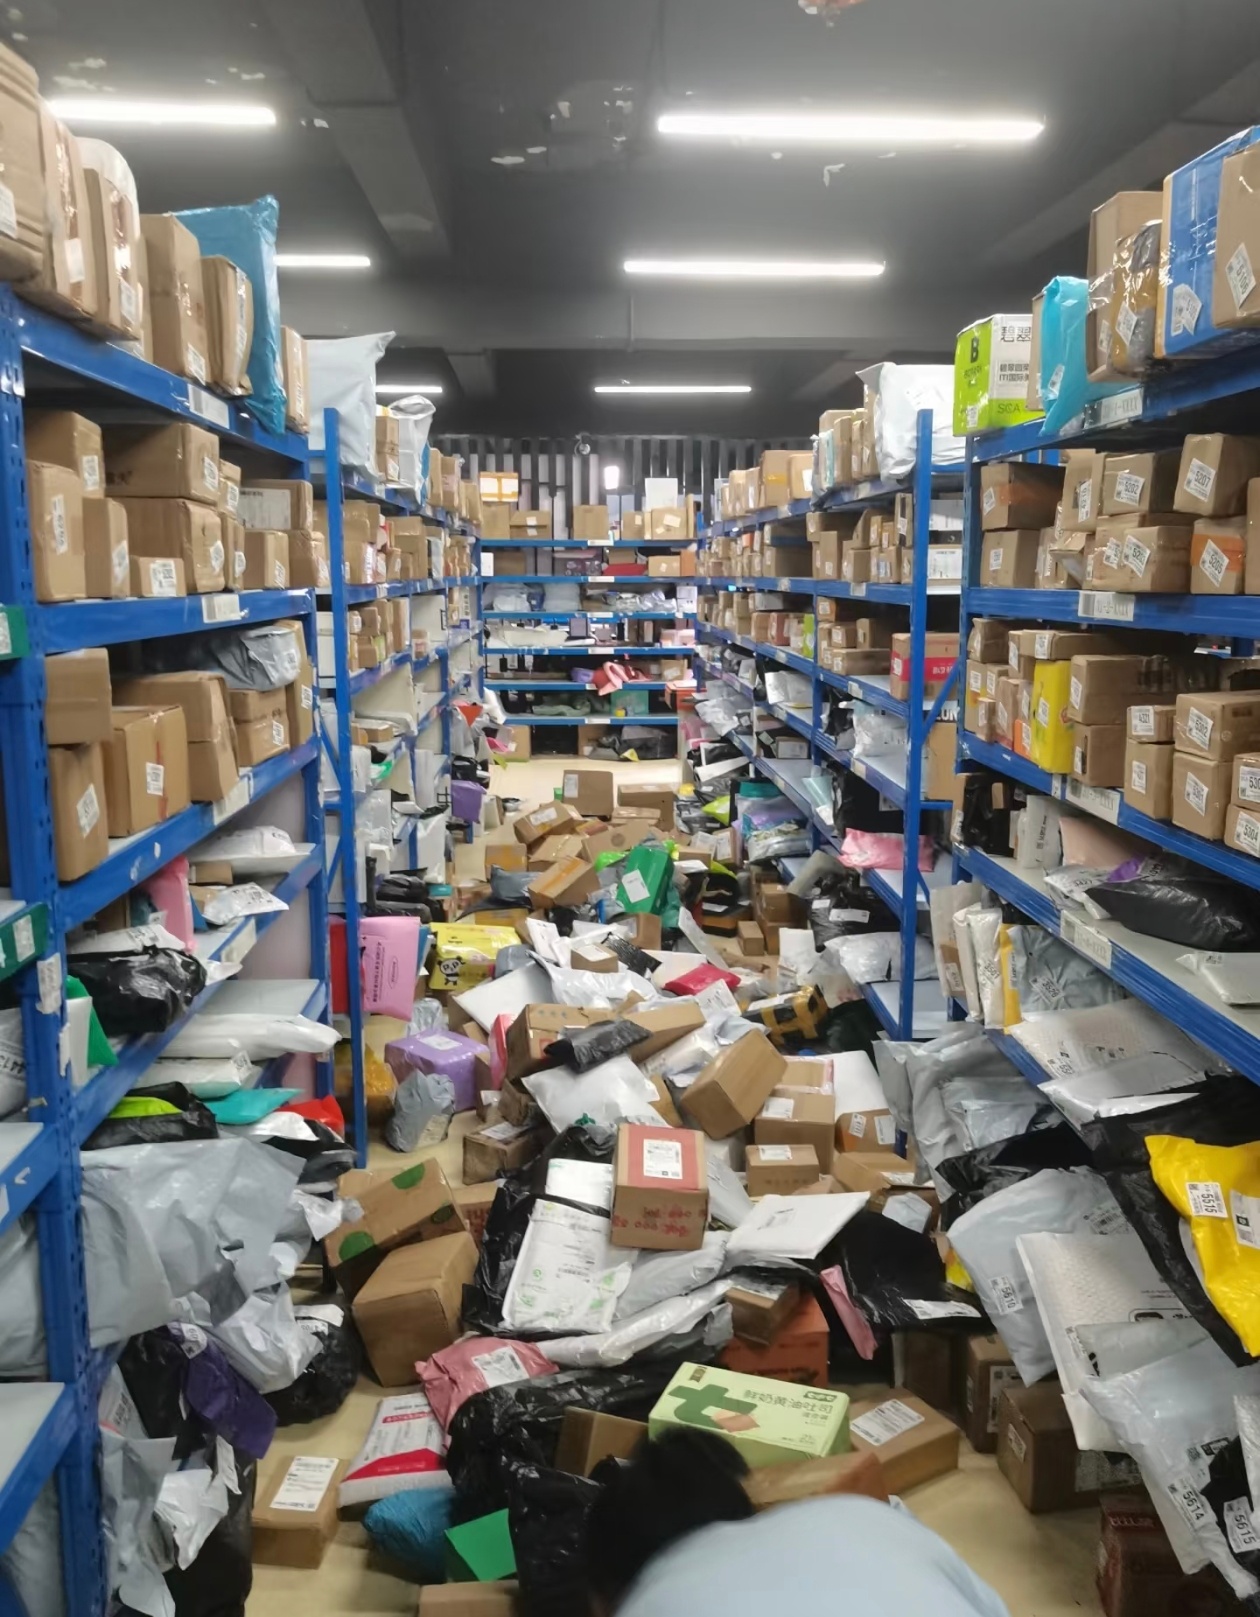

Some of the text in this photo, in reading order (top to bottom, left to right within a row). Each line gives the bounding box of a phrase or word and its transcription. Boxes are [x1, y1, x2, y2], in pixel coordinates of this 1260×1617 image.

[970, 337, 979, 363] B
[1201, 1193, 1217, 1214] 5515
[1001, 1287, 1017, 1309] 5610
[1181, 1490, 1204, 1521] 5614
[1234, 1513, 1257, 1545] 5615
